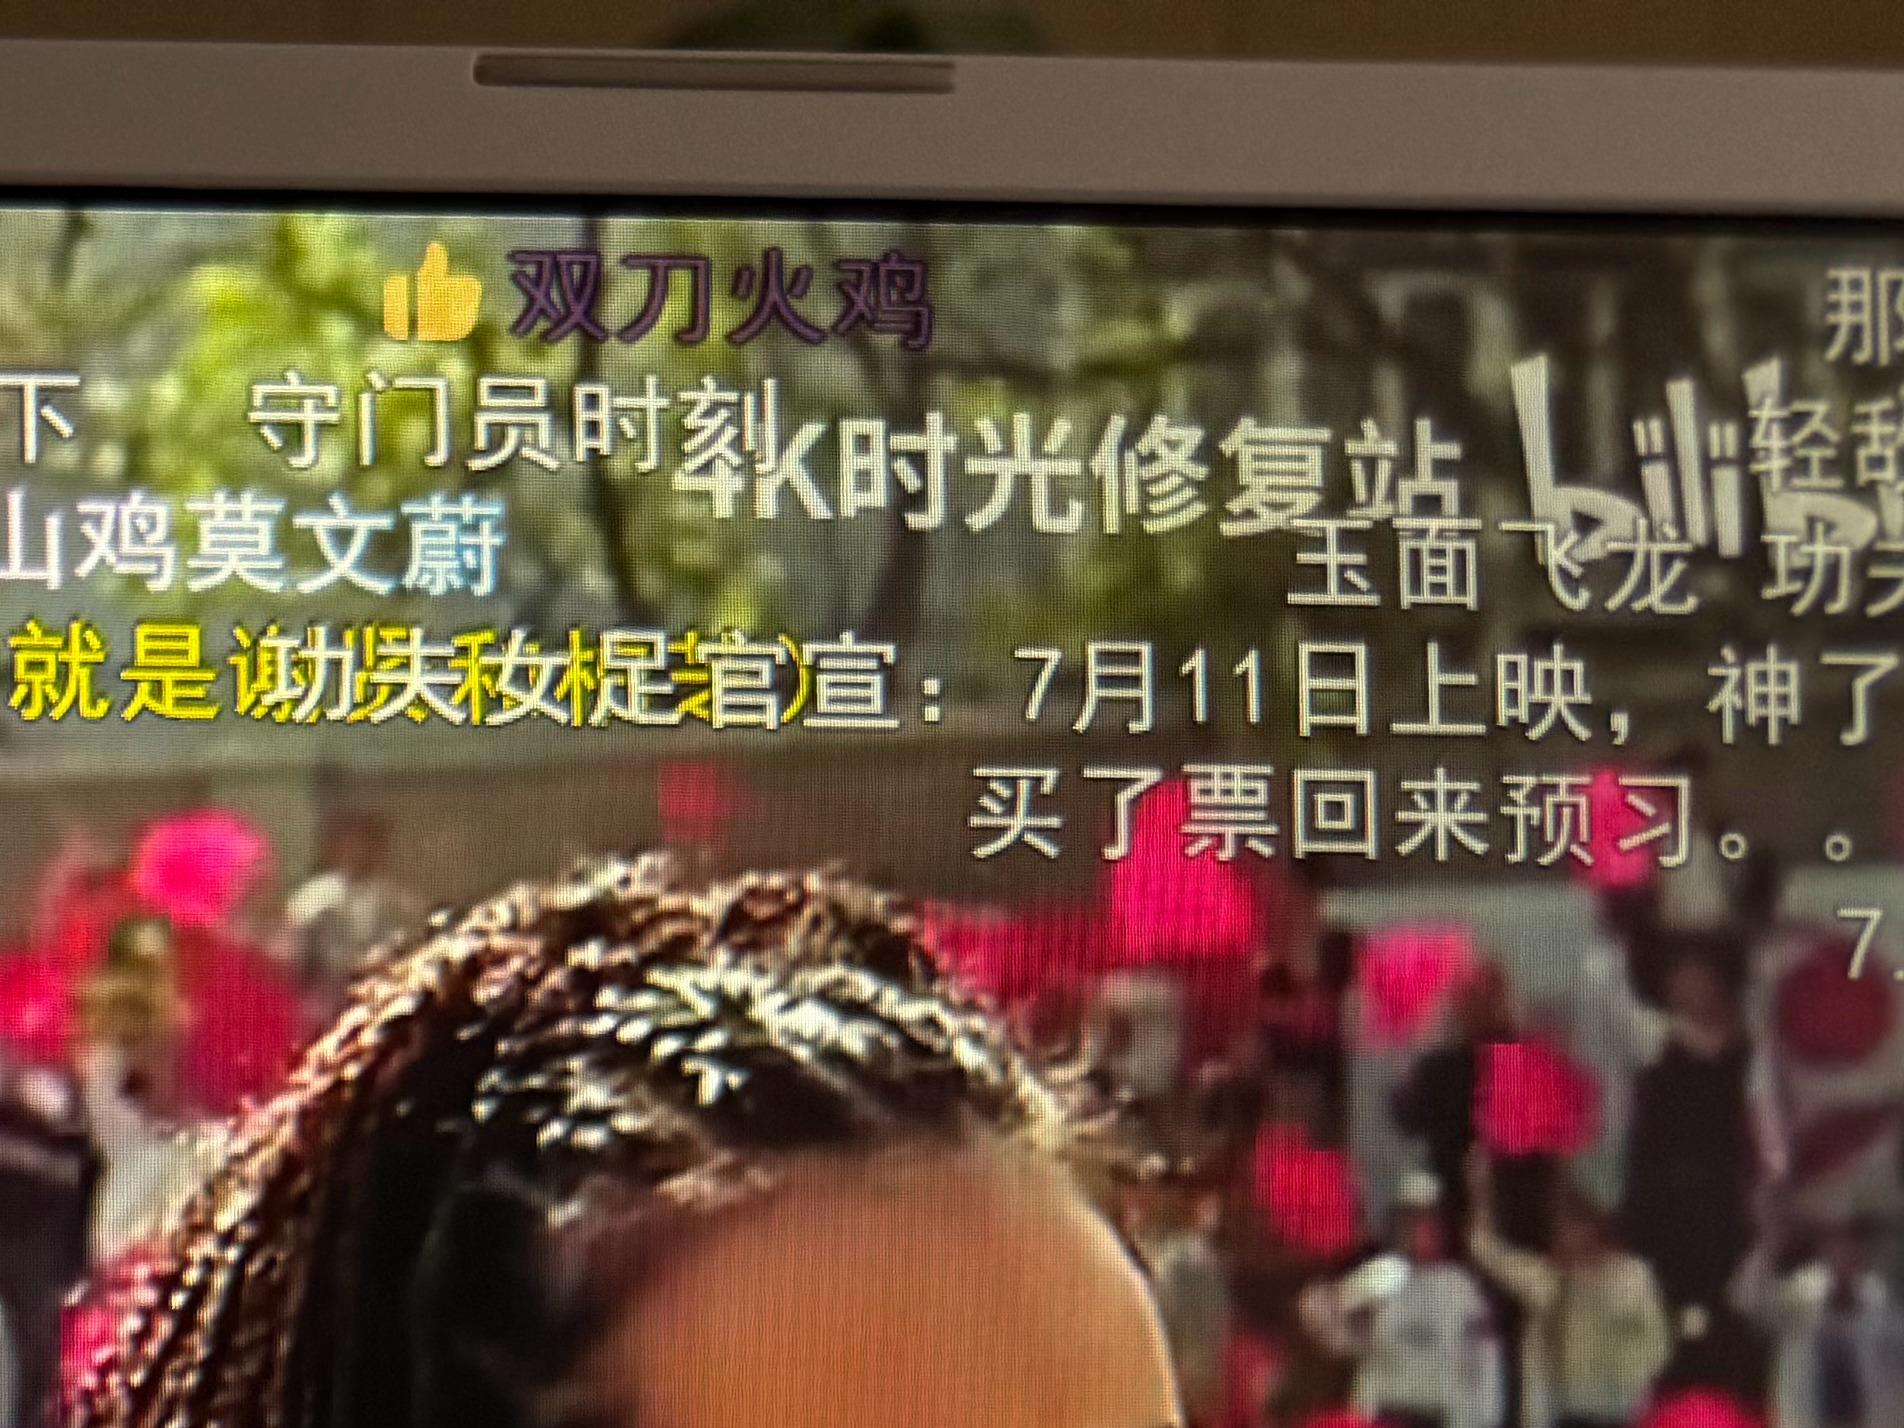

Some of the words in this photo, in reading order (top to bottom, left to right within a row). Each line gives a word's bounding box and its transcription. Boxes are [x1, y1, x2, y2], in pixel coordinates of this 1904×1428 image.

[508, 245, 932, 352] 双刀火鸡
[247, 370, 780, 478] 守门员时刻
[1286, 517, 1700, 616] 玉面飞龙
